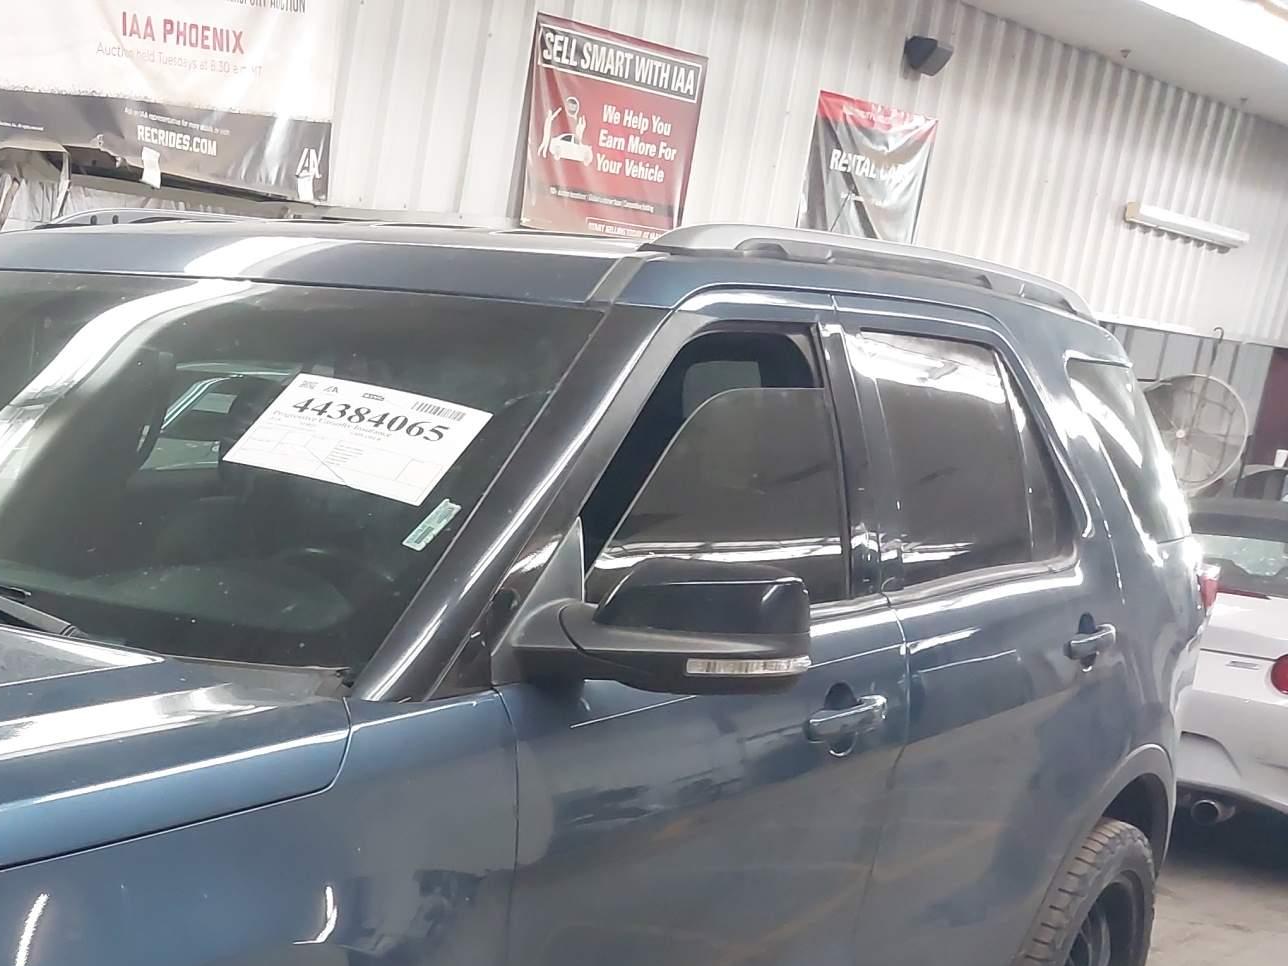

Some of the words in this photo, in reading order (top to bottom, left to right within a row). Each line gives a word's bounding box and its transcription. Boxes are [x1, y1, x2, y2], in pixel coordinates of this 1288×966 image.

[122, 11, 155, 41] IAA
[162, 18, 244, 54] PHOENIX
[542, 31, 578, 67] SELL
[580, 41, 634, 79] SMART
[634, 55, 672, 90] WITH
[670, 65, 695, 96] IAA
[602, 104, 621, 125] We
[623, 108, 649, 134] Help
[651, 114, 672, 136] You
[137, 125, 217, 156] RECRIDES.COM
[598, 129, 625, 151] Earn
[627, 135, 657, 157] More
[658, 141, 677, 161] For
[596, 153, 623, 175] Your
[624, 158, 665, 183] Vehicle
[292, 398, 450, 442] 44384065
